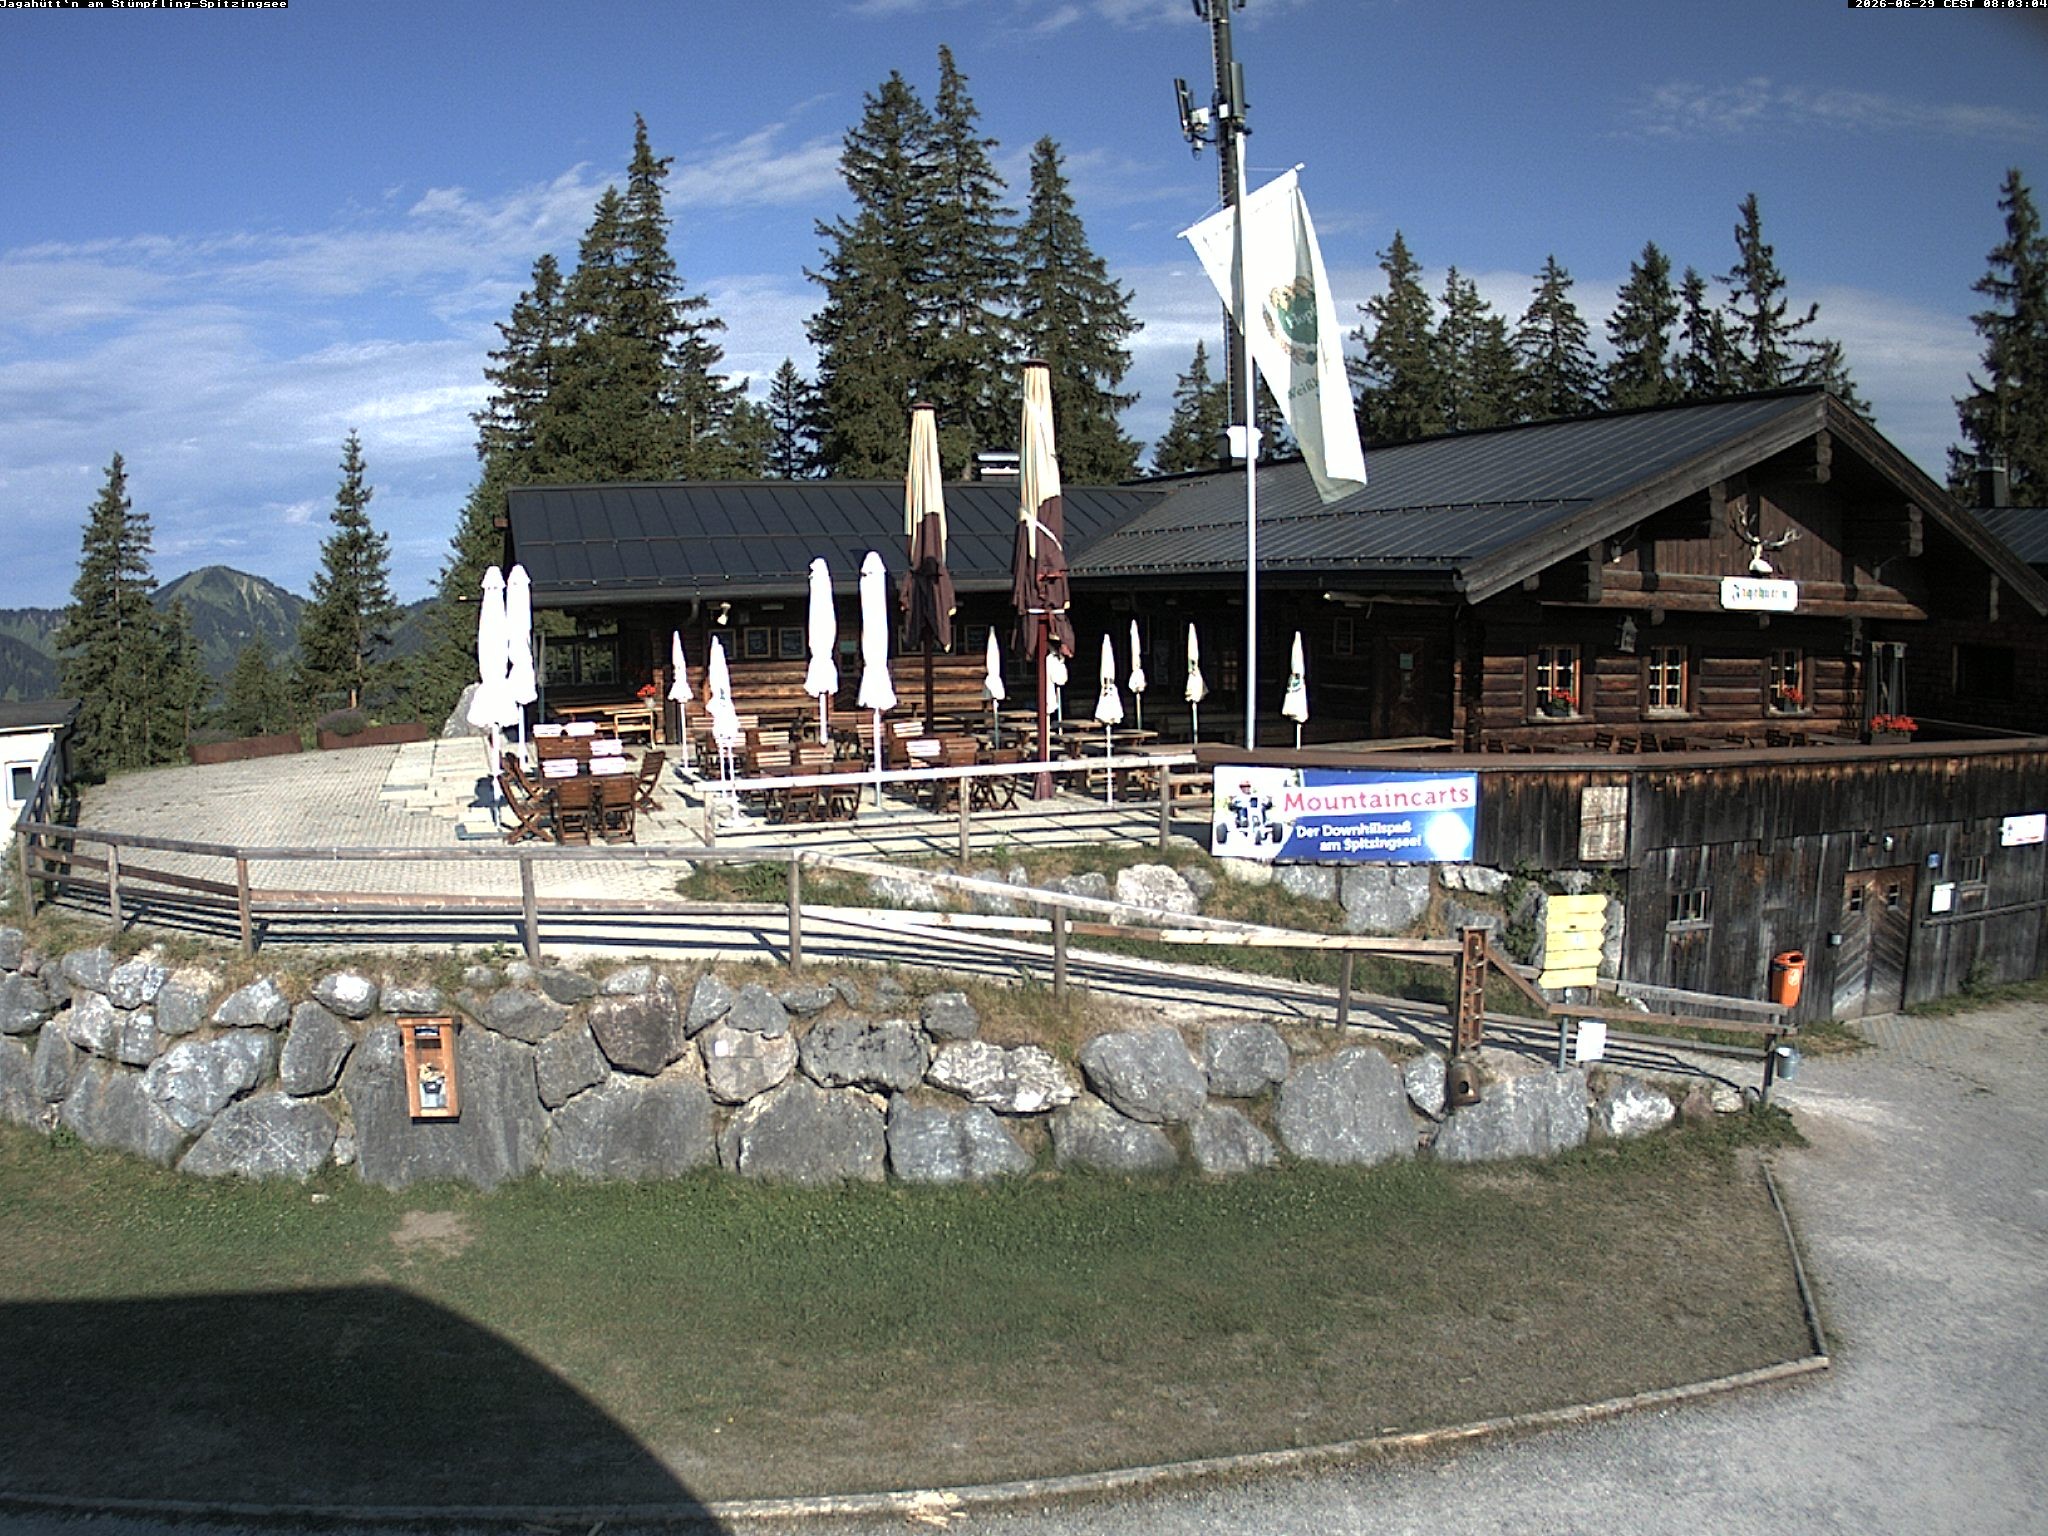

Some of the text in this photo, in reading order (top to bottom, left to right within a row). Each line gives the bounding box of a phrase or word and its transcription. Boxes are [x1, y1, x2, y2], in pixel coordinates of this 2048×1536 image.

[1284, 786, 1469, 812] Mountaincarts
[1296, 820, 1412, 838] Der Downhillspaß
[1320, 834, 1422, 853] am Spitzingsee!
